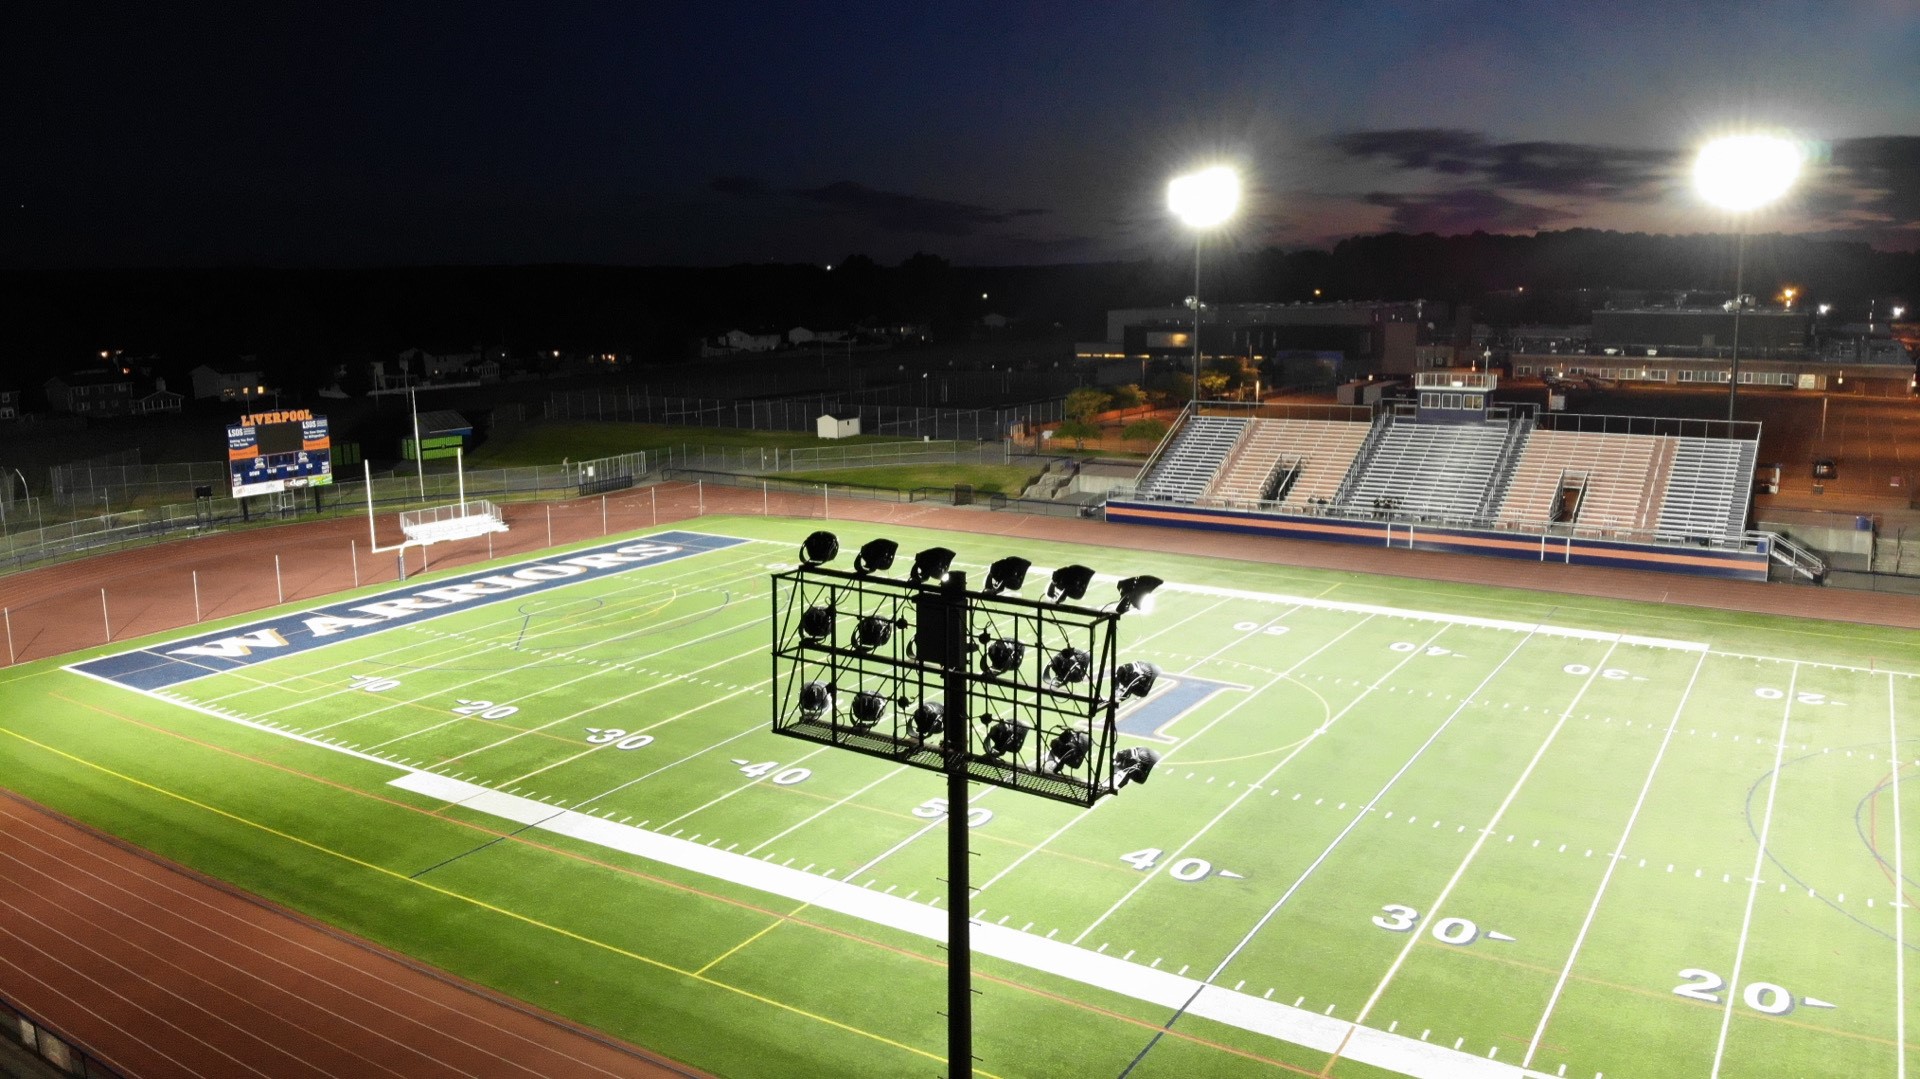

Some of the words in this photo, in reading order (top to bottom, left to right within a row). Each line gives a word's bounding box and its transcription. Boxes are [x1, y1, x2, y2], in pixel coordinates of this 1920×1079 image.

[241, 409, 313, 427] LIVERPOOL
[165, 543, 683, 657] WARRIORS
[1388, 641, 1452, 656] 40
[1562, 664, 1630, 681] 30
[1754, 688, 1826, 705] 20
[452, 700, 520, 720] 20
[586, 728, 655, 751] 30
[738, 760, 812, 786] 40
[911, 797, 995, 829] 50
[1119, 847, 1214, 883] 40
[1371, 904, 1481, 946] 30
[1672, 968, 1795, 1016] 20
